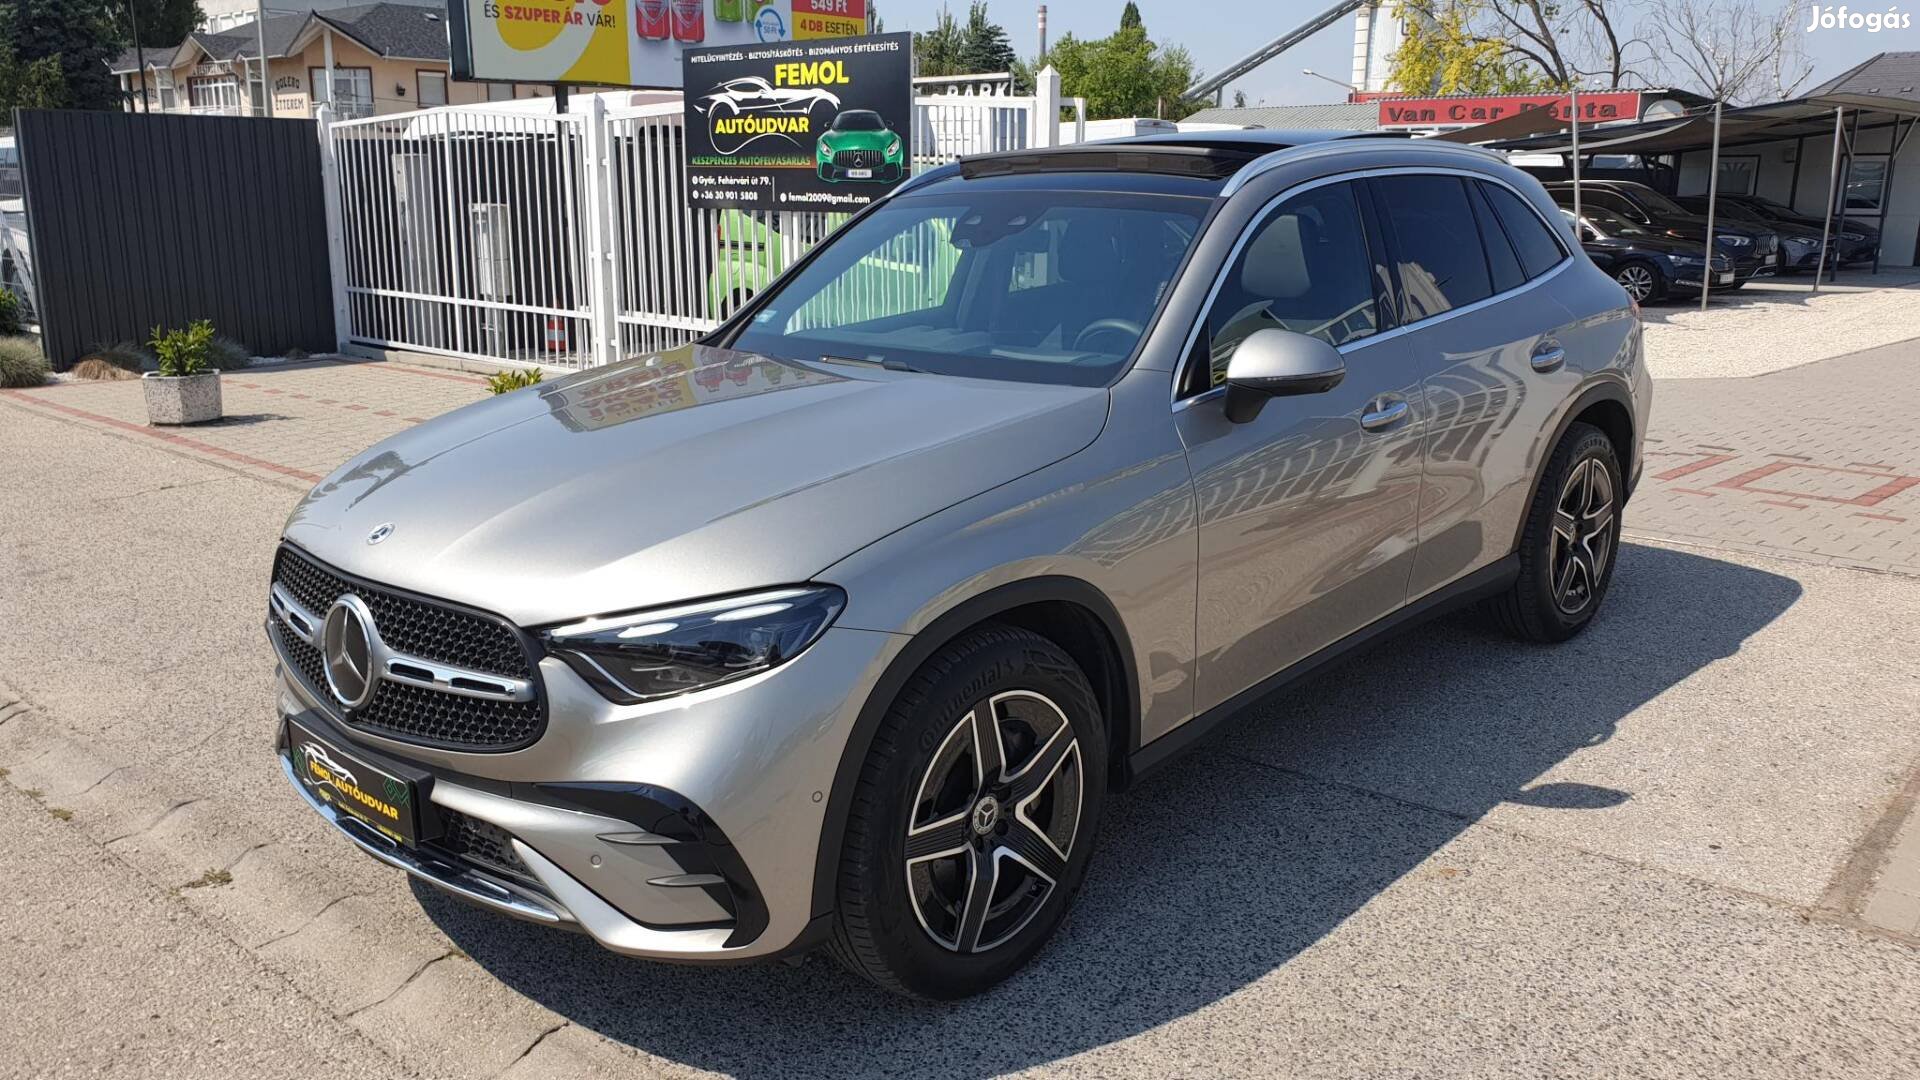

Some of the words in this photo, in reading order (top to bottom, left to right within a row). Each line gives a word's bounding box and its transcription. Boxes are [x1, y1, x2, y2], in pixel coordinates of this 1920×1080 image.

[484, 1, 500, 18] ÉS
[504, 5, 560, 24] SZUPER
[563, 7, 583, 25] ÁR
[586, 10, 616, 28] VÁR!
[836, 0, 848, 13] Ft
[800, 19, 807, 31] 4
[809, 20, 823, 32] DB
[825, 21, 858, 35] ESETÉN
[809, 45, 852, 56] BIZOMÁNYOS
[775, 61, 849, 86] FEMOL
[1388, 106, 1436, 122] Van
[1449, 104, 1504, 120] Car
[715, 114, 810, 134] AUTÓUDVAR
[715, 191, 724, 200] 30
[725, 191, 738, 200] 901
[334, 777, 400, 820] AUTÓUDVAR
